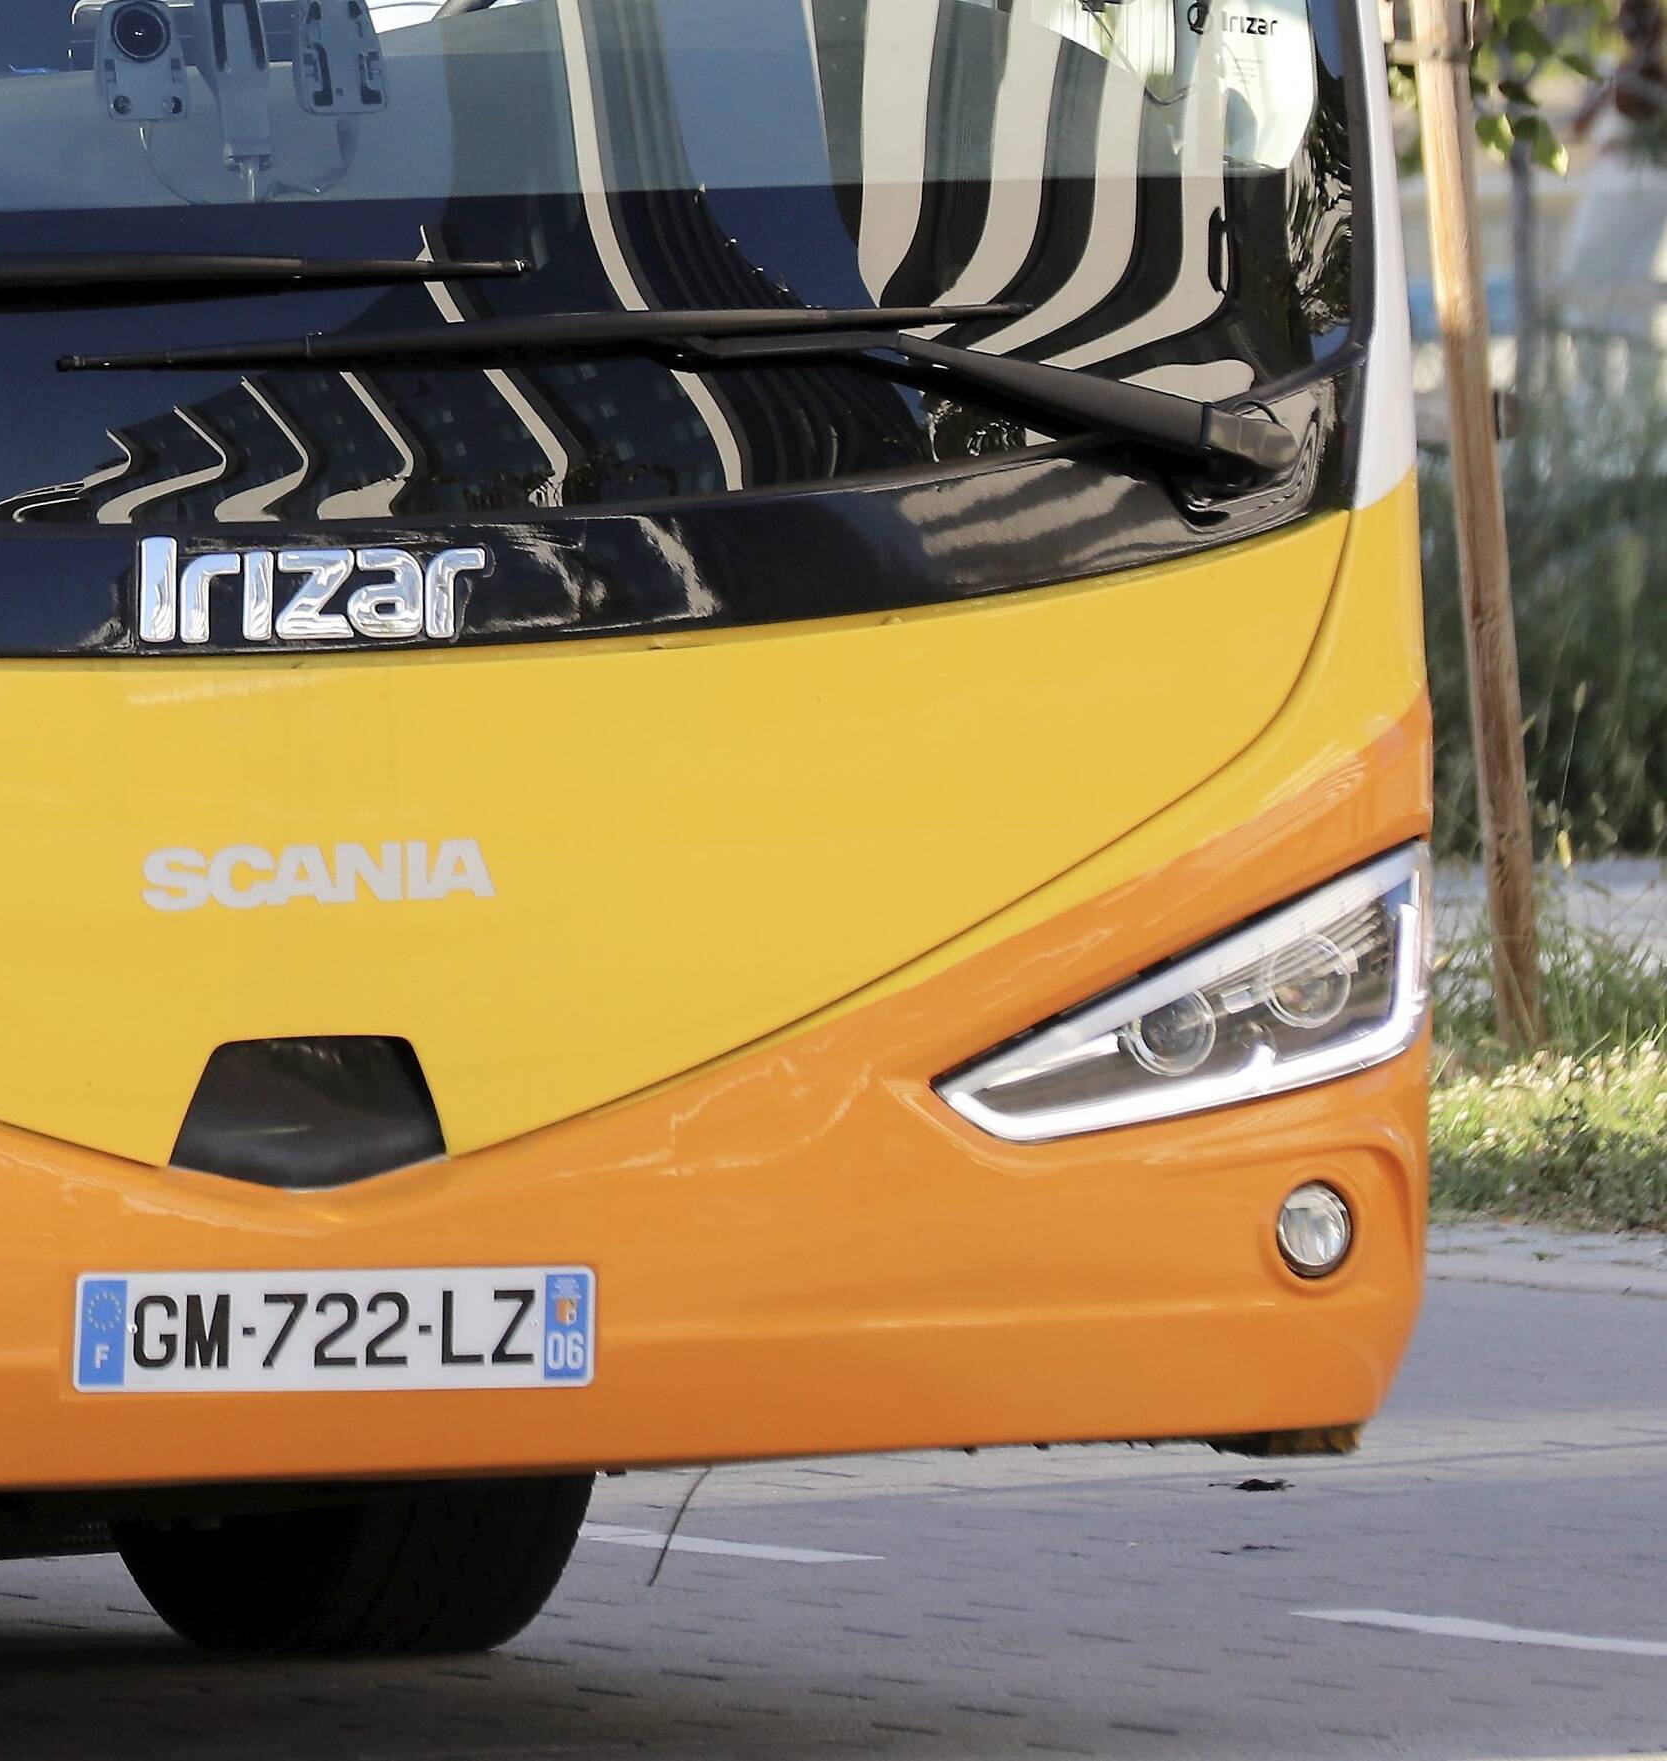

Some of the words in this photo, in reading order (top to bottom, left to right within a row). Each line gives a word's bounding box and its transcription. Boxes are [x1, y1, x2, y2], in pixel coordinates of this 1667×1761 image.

[1220, 10, 1279, 37] Irizar
[139, 535, 487, 644] Irizar
[142, 838, 496, 912] SCANIA
[92, 1344, 110, 1369] F
[132, 1289, 537, 1370] GM-722-LZ
[547, 1330, 585, 1371] 06
